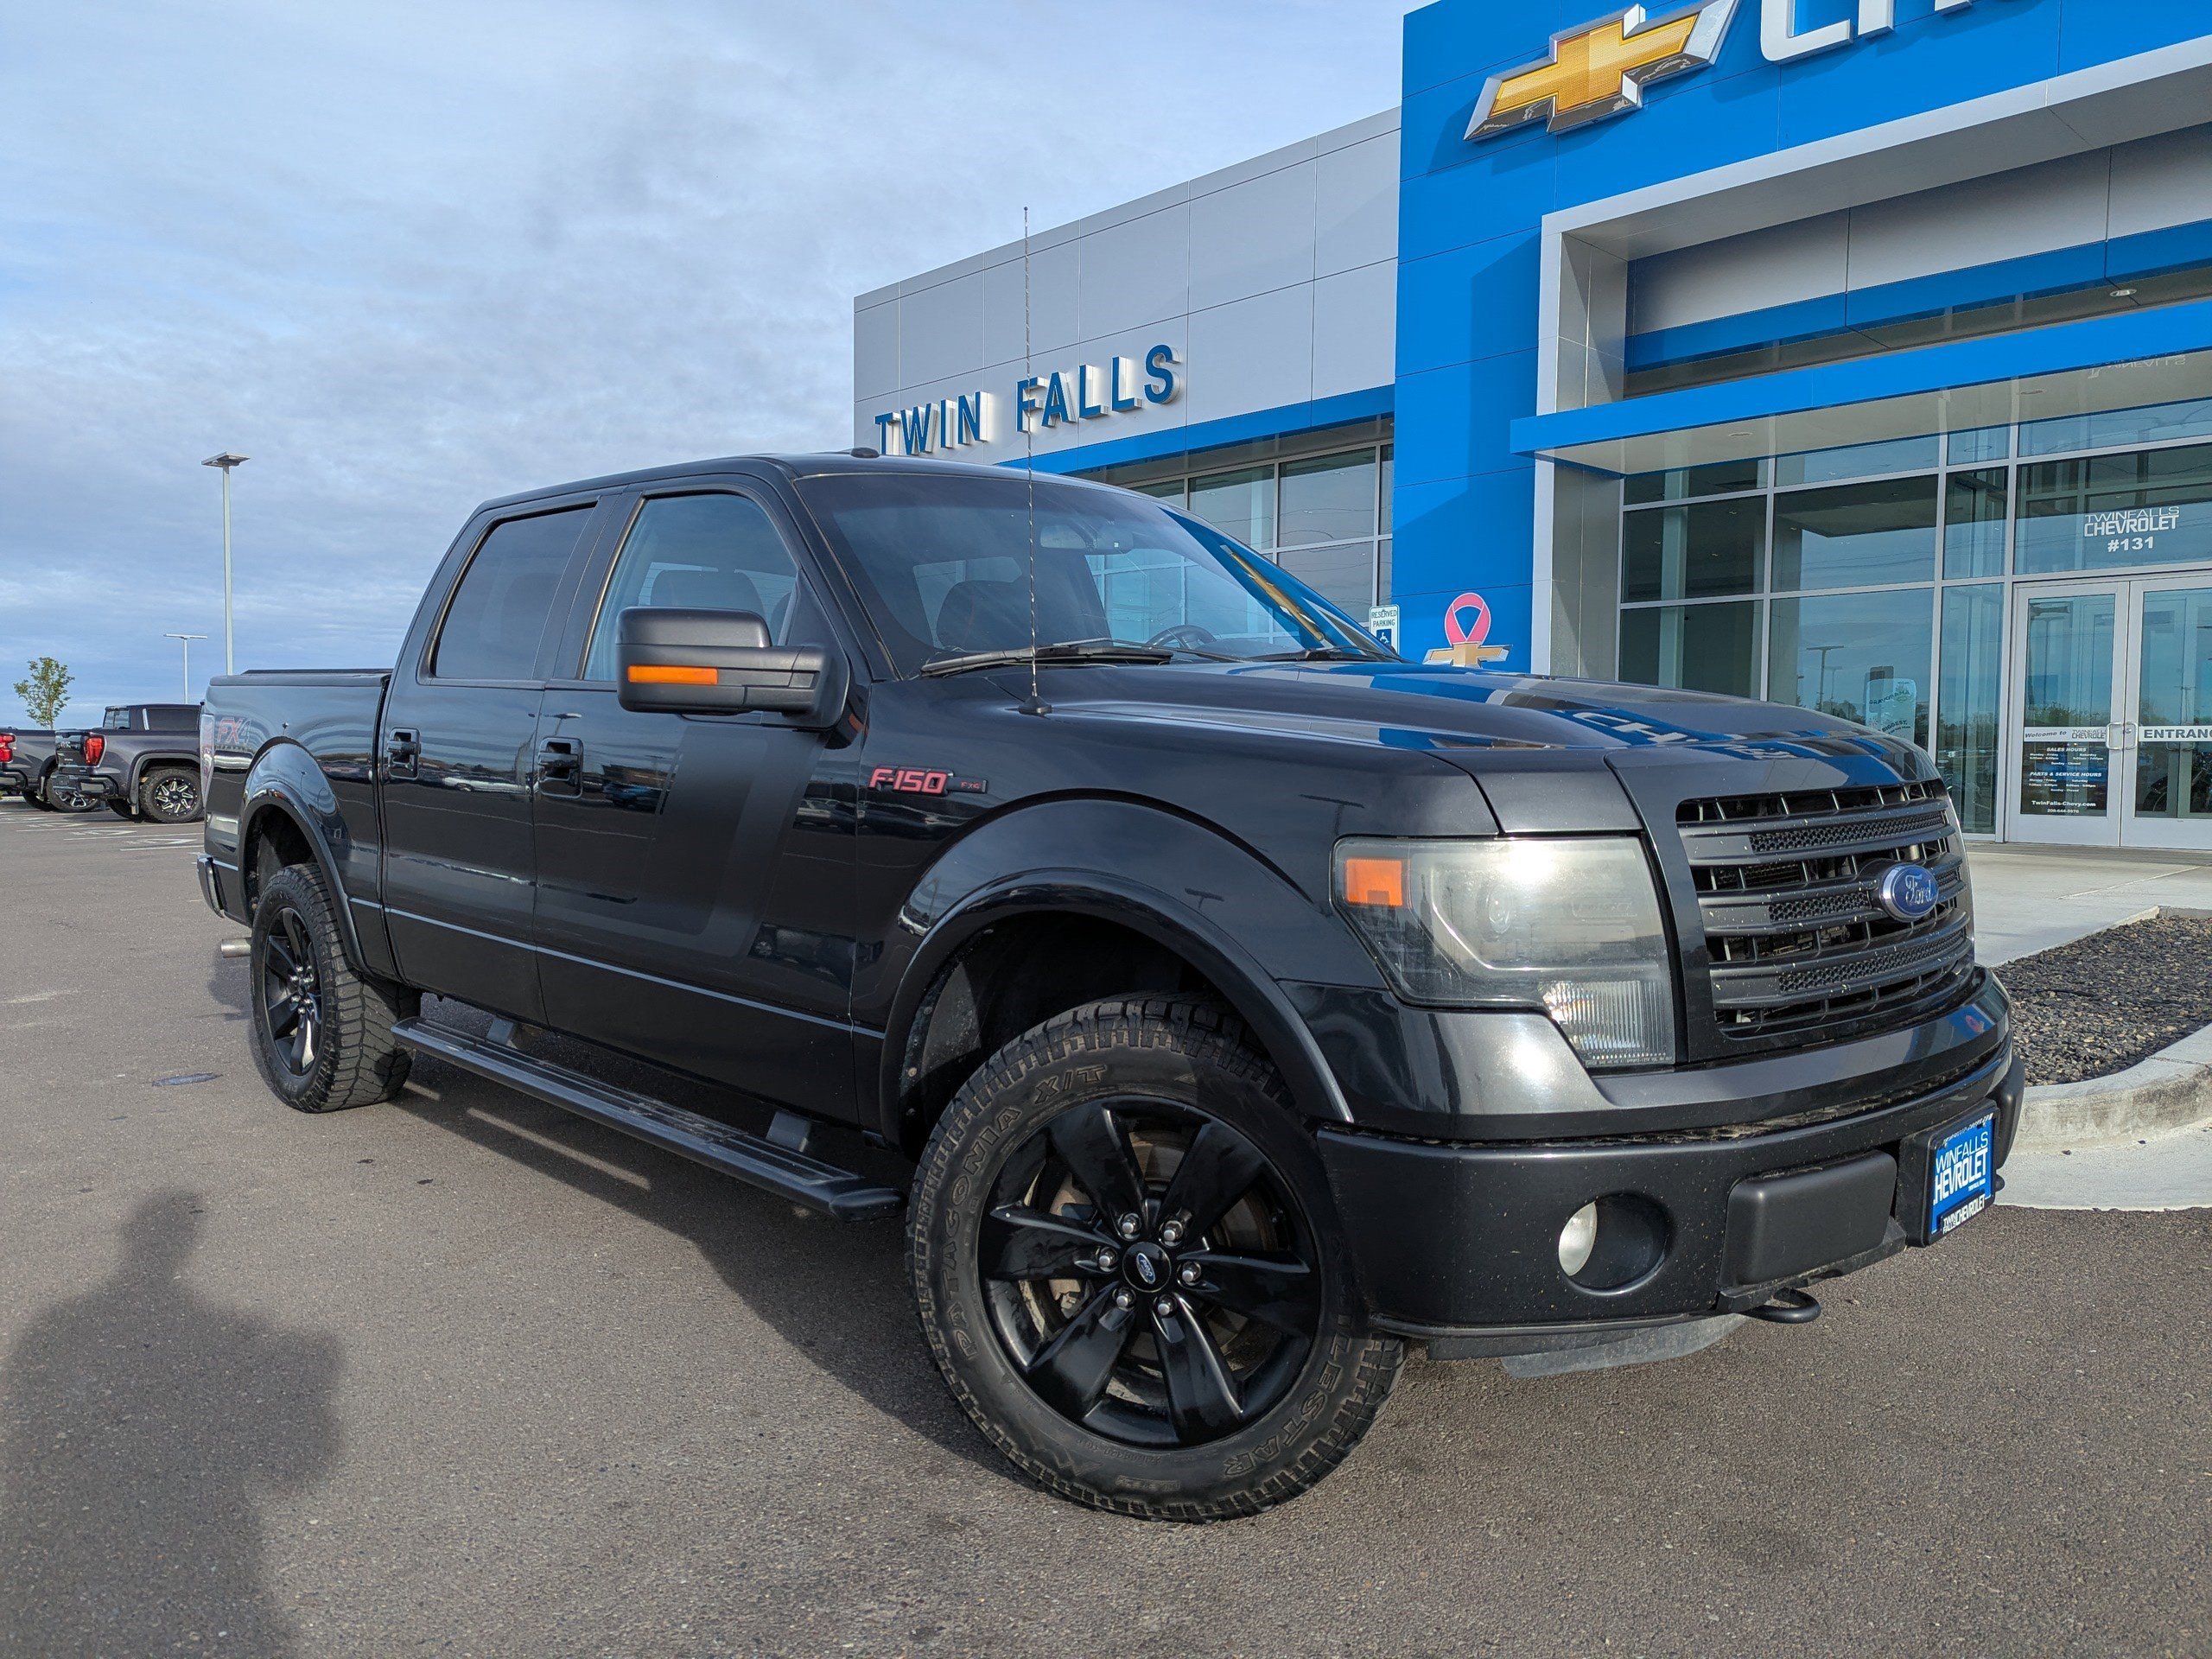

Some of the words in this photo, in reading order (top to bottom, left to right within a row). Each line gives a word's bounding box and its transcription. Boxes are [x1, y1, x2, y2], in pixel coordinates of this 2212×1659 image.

[874, 391, 983, 455] TWIN
[1017, 344, 1177, 432] FALLS
[2084, 515, 2179, 537] CHEVROLET
[2107, 536, 2154, 552] #131
[1371, 609, 1397, 618] RESERVED
[1372, 619, 1395, 627] PARKING
[217, 717, 252, 745] FX4
[2144, 728, 2212, 739] ENTRAN
[868, 767, 949, 794] F-150
[1904, 873, 1935, 906] Ford
[1034, 1065, 1108, 1104] X/T
[1935, 1131, 1988, 1173] WINFALLS
[1933, 1147, 1988, 1205] HEVROLET
[1955, 1193, 1986, 1226] CHEVROLET
[942, 1106, 1023, 1359] PATAGONIA
